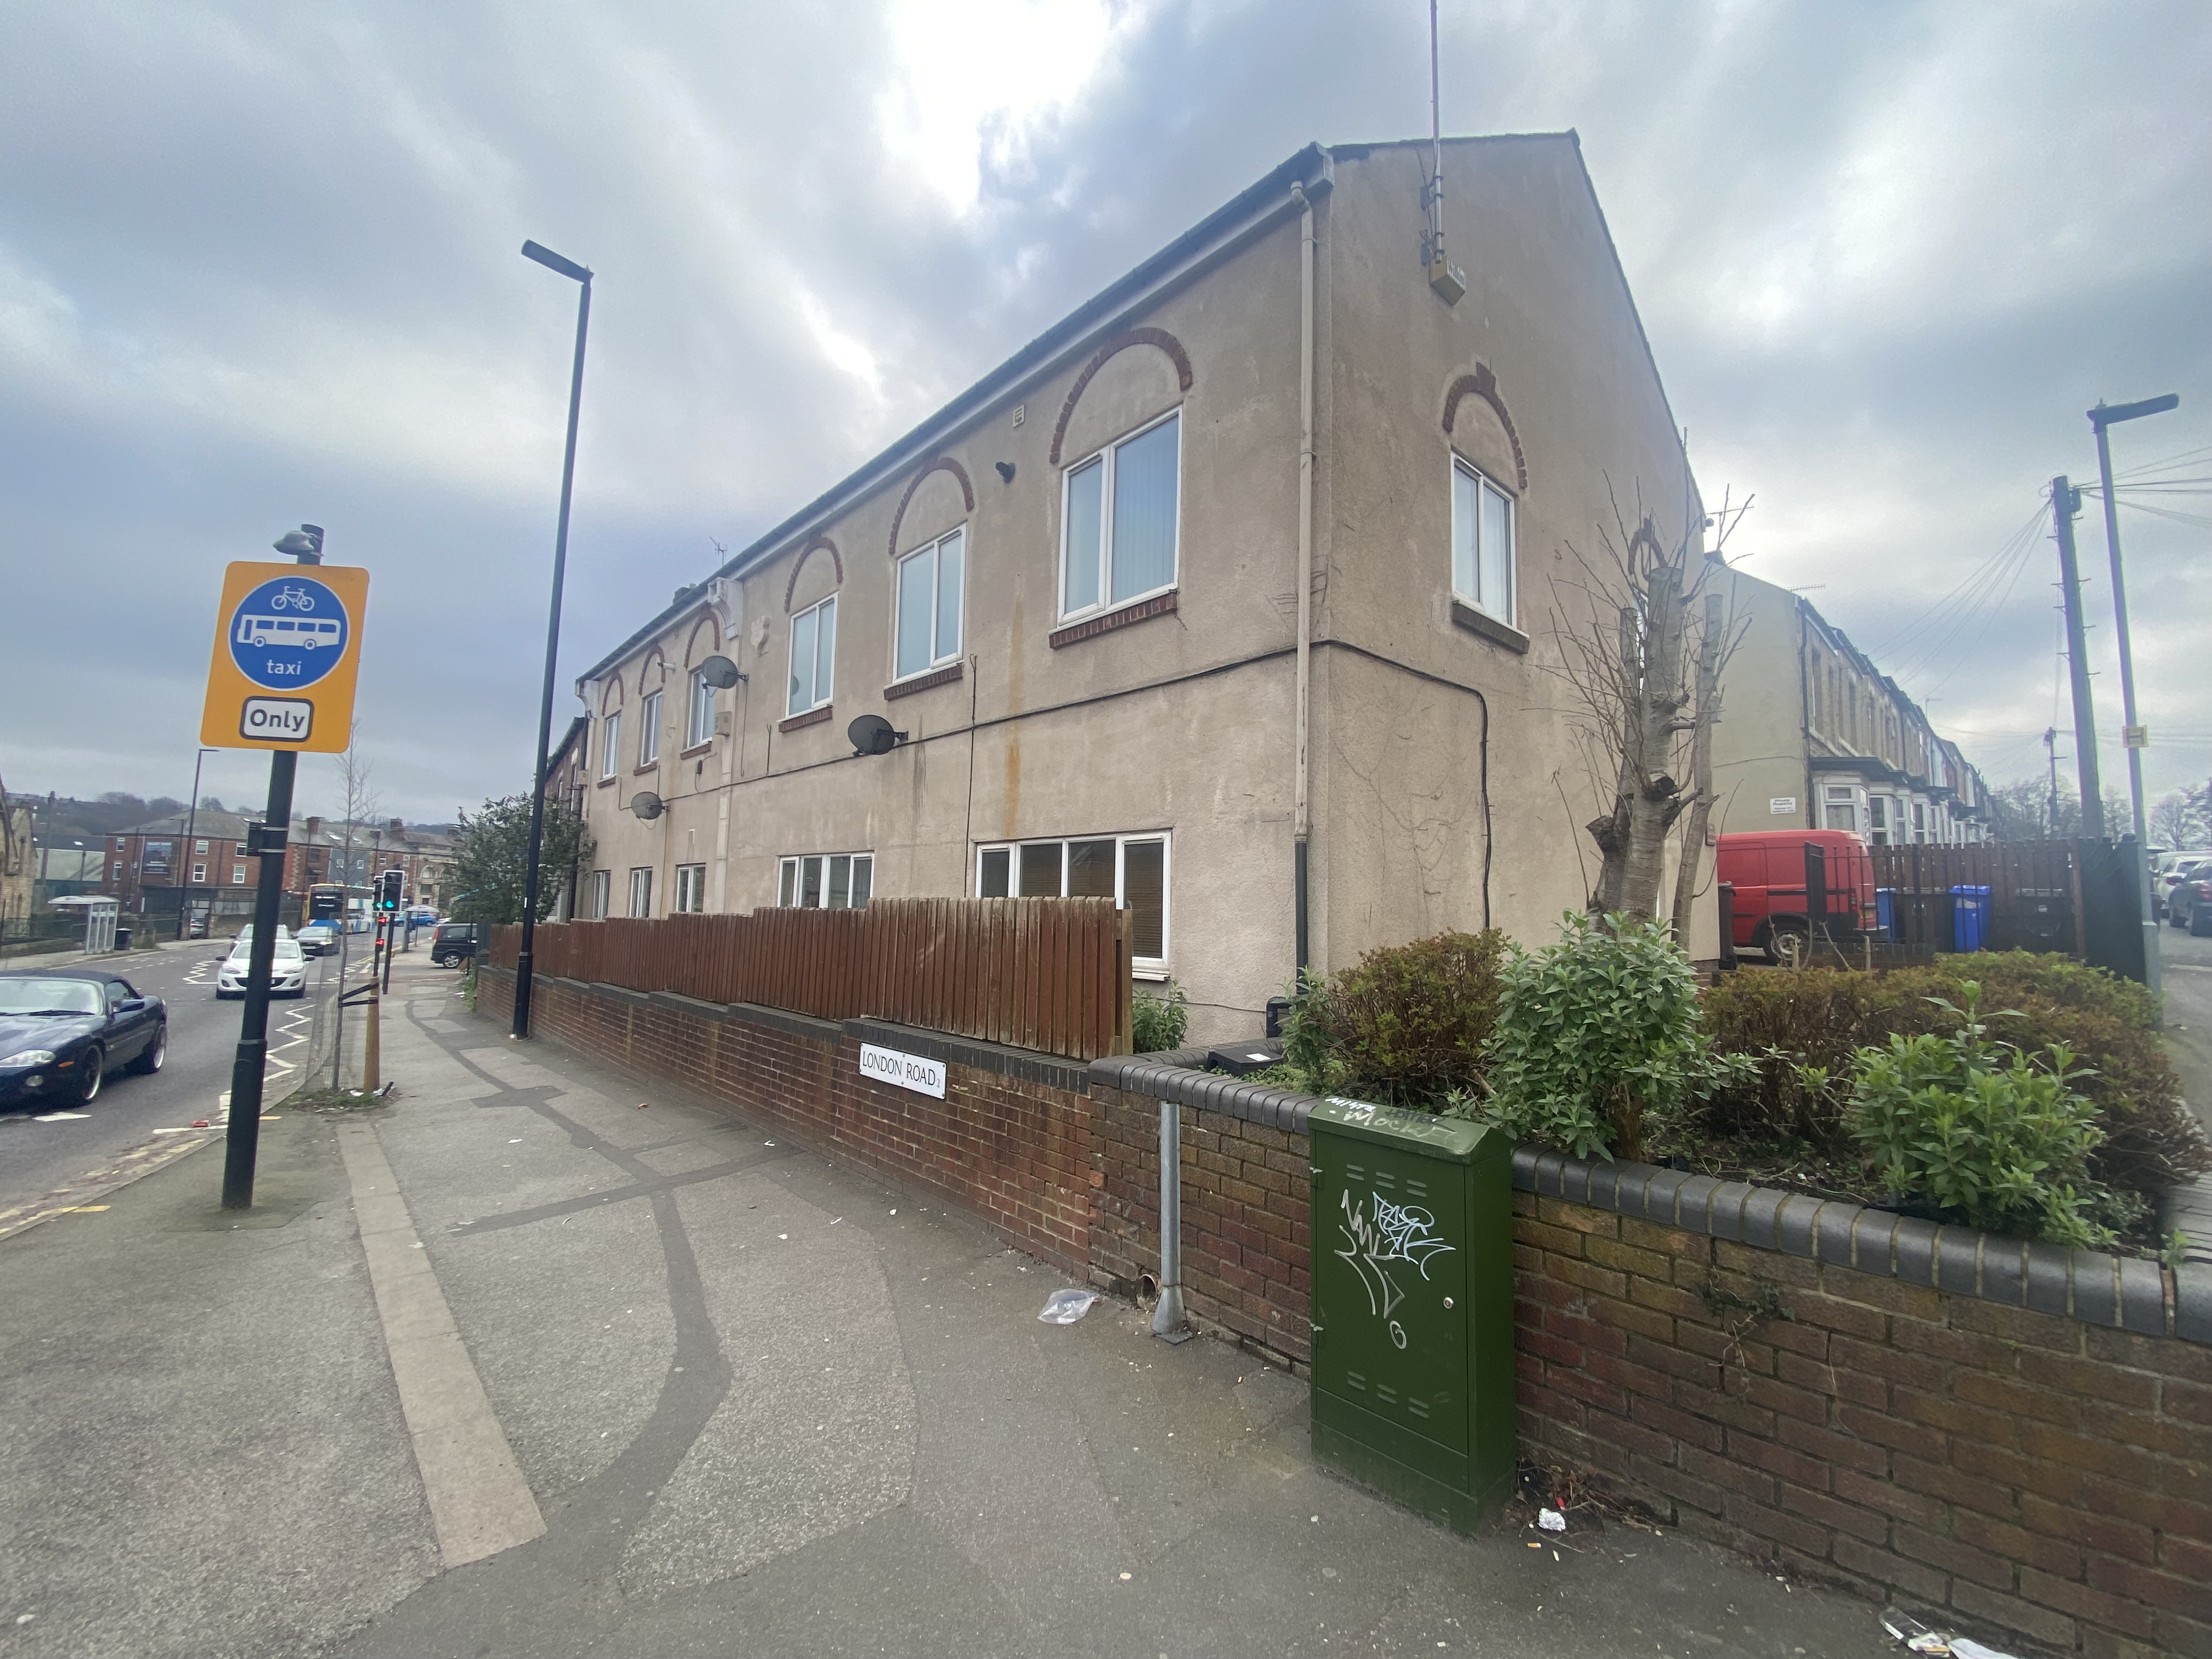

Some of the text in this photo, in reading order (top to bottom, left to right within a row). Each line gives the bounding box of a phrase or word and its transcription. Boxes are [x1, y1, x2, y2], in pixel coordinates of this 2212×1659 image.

[267, 659, 302, 675] taxi
[250, 709, 305, 732] Only
[862, 1051, 940, 1088] LONDON ROAD 2
